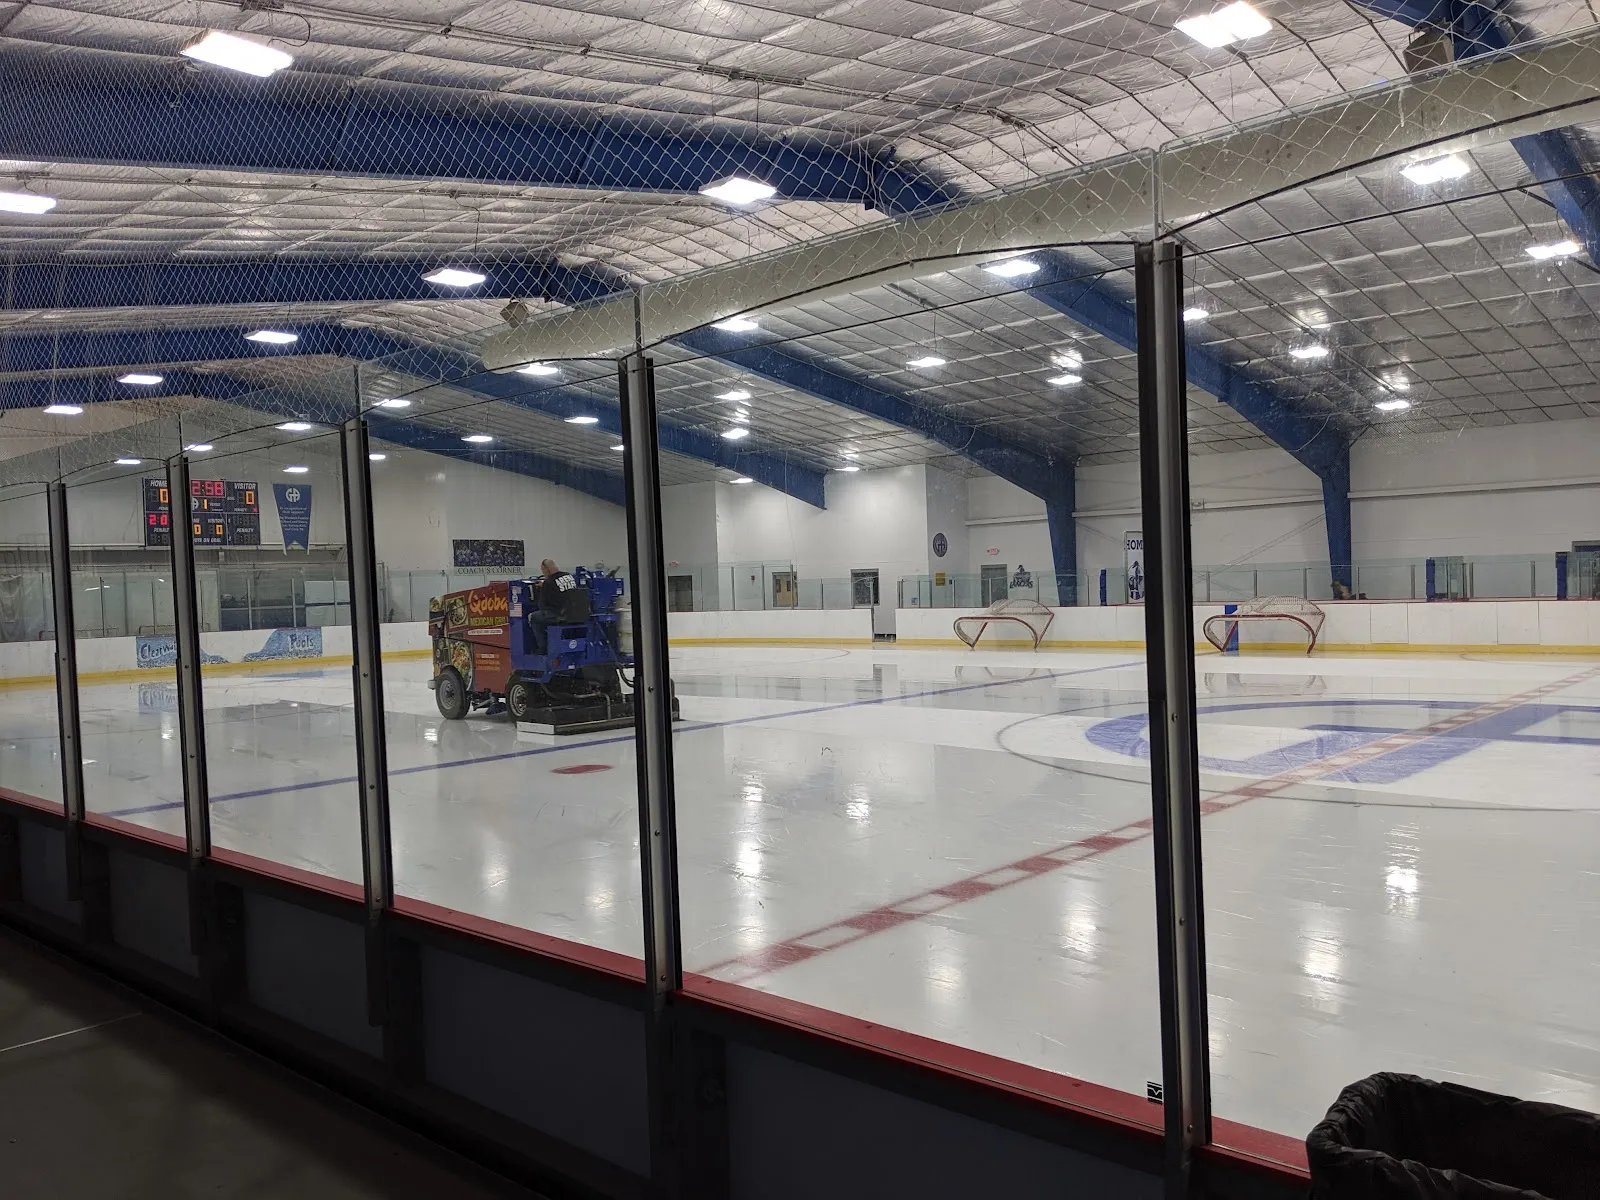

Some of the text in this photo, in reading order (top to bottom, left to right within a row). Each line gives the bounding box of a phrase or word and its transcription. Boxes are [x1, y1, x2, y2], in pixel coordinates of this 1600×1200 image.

[150, 480, 168, 488] HOME
[234, 482, 257, 490] VISITOR
[160, 488, 169, 504] 0
[245, 490, 255, 505] 0
[216, 523, 223, 535] 0
[1124, 539, 1144, 550] HOM
[457, 566, 523, 575] COACH'S CORNER
[470, 617, 495, 627] MEXICAN
[288, 633, 314, 651] Pools
